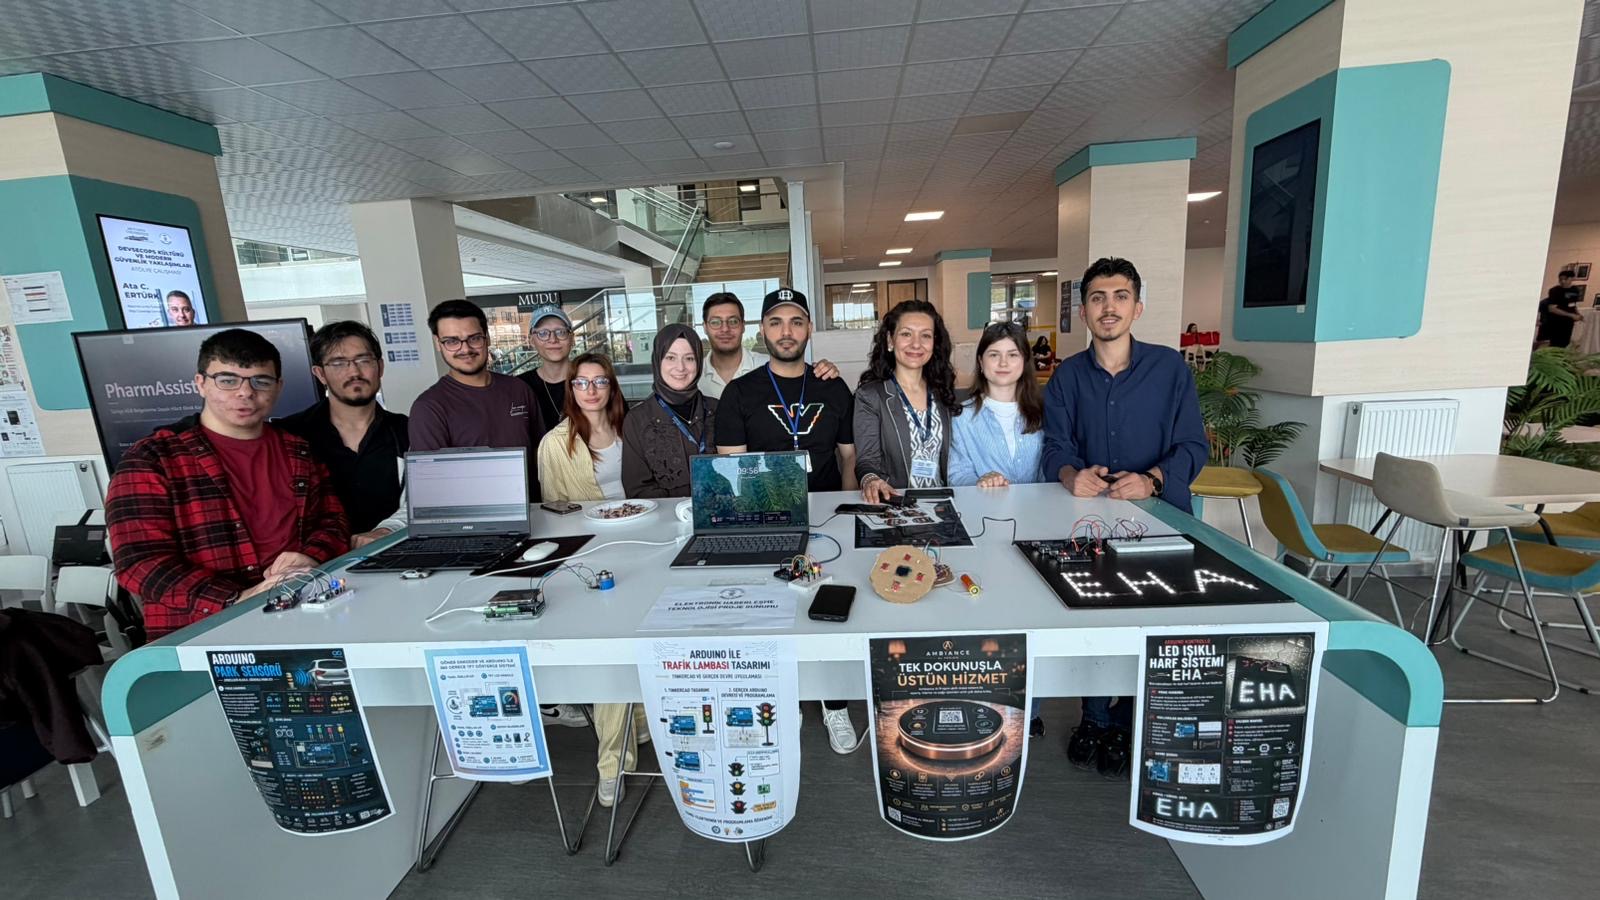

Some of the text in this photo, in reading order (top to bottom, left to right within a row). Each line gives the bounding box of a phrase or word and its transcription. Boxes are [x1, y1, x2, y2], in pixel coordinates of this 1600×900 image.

[125, 291, 160, 300] ERTÜRK
[518, 292, 558, 306] MUDU
[736, 467, 759, 475] 09:56
[690, 648, 741, 659] ARDUINO İLE
[1158, 644, 1216, 657] LED IŞIKLI
[211, 653, 256, 665] ARDUINO
[662, 659, 771, 670] TRAFİK LAMBASI TASARIMI
[1149, 654, 1225, 669] HARF SİSTEMİ
[214, 665, 240, 677] PARK
[899, 660, 1002, 673] TEK DOKUNUŞLA
[897, 671, 1008, 687] ÜSTÜN HİZMET
[1172, 669, 1202, 681] EHA
[1156, 797, 1218, 819] EHA
